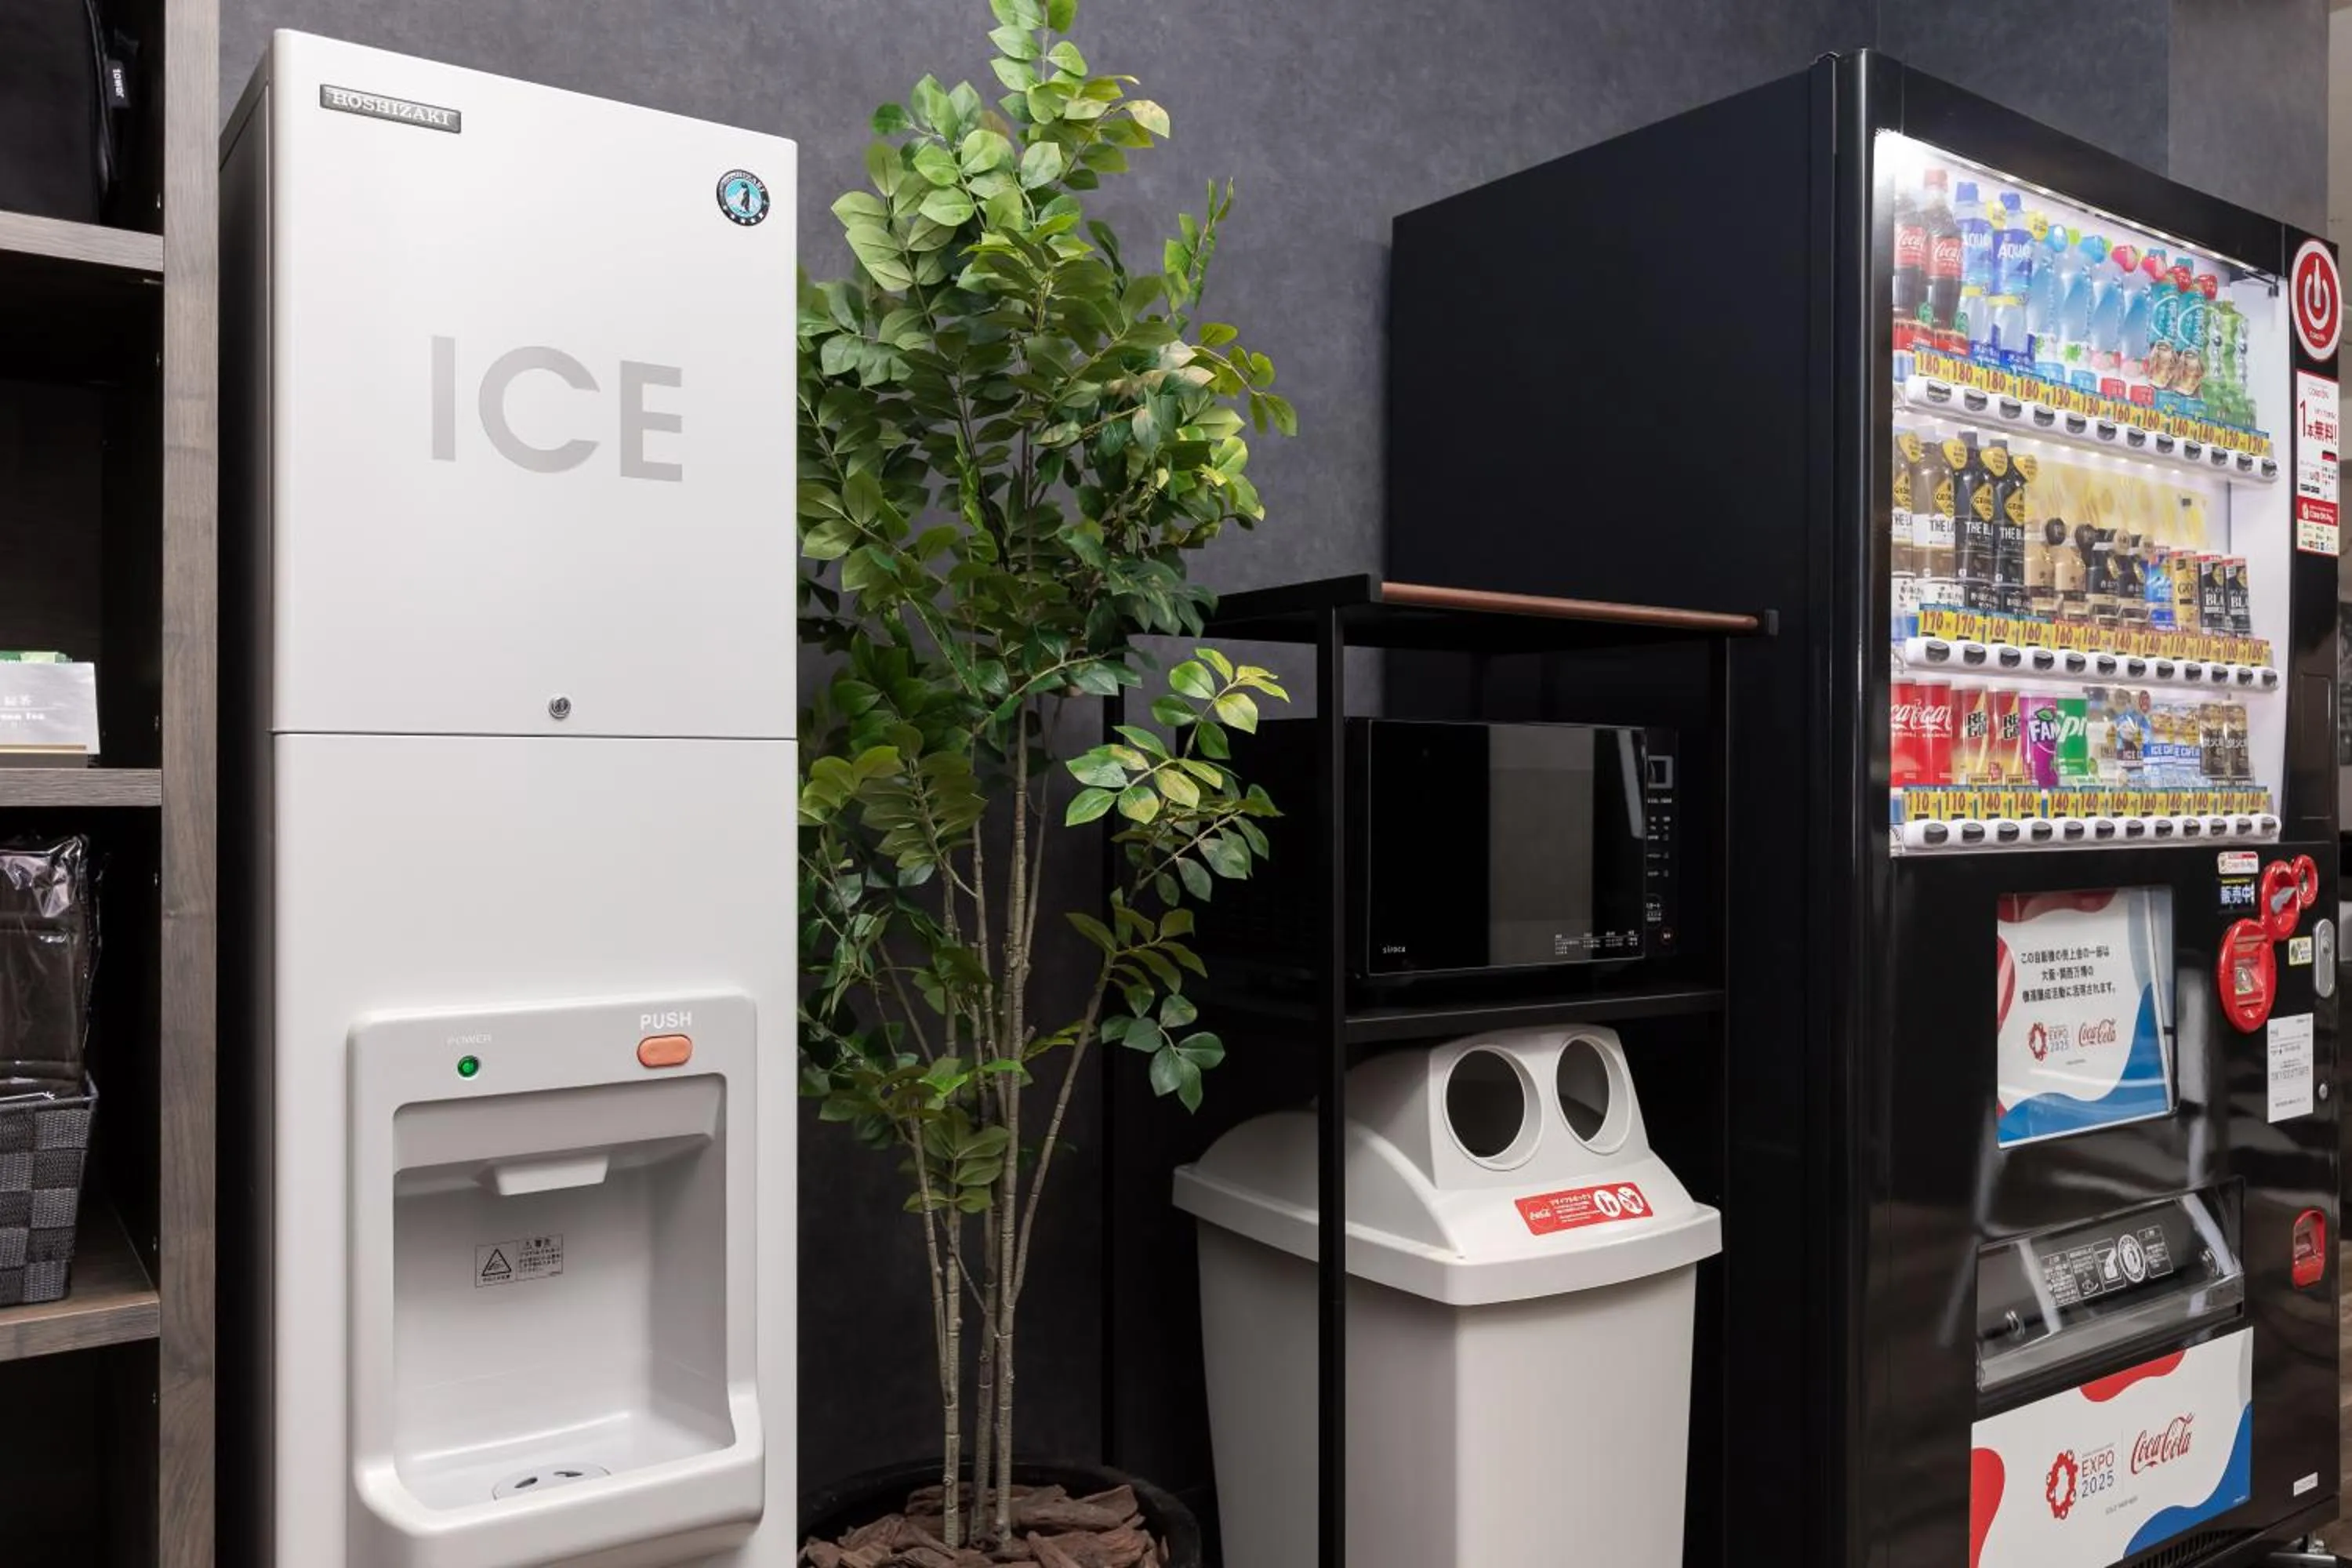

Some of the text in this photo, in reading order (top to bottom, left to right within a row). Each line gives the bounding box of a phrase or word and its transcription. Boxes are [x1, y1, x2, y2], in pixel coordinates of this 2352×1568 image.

[332, 92, 449, 125] HOSHIZAKI
[1985, 368, 2006, 390] 180
[431, 335, 684, 482] ICE
[640, 1011, 692, 1030] PUSH
[448, 1033, 492, 1045] POWER
[2130, 1412, 2194, 1475] Coca-Cola
[2082, 1450, 2114, 1478] EXPO
[2082, 1470, 2114, 1498] 2025
